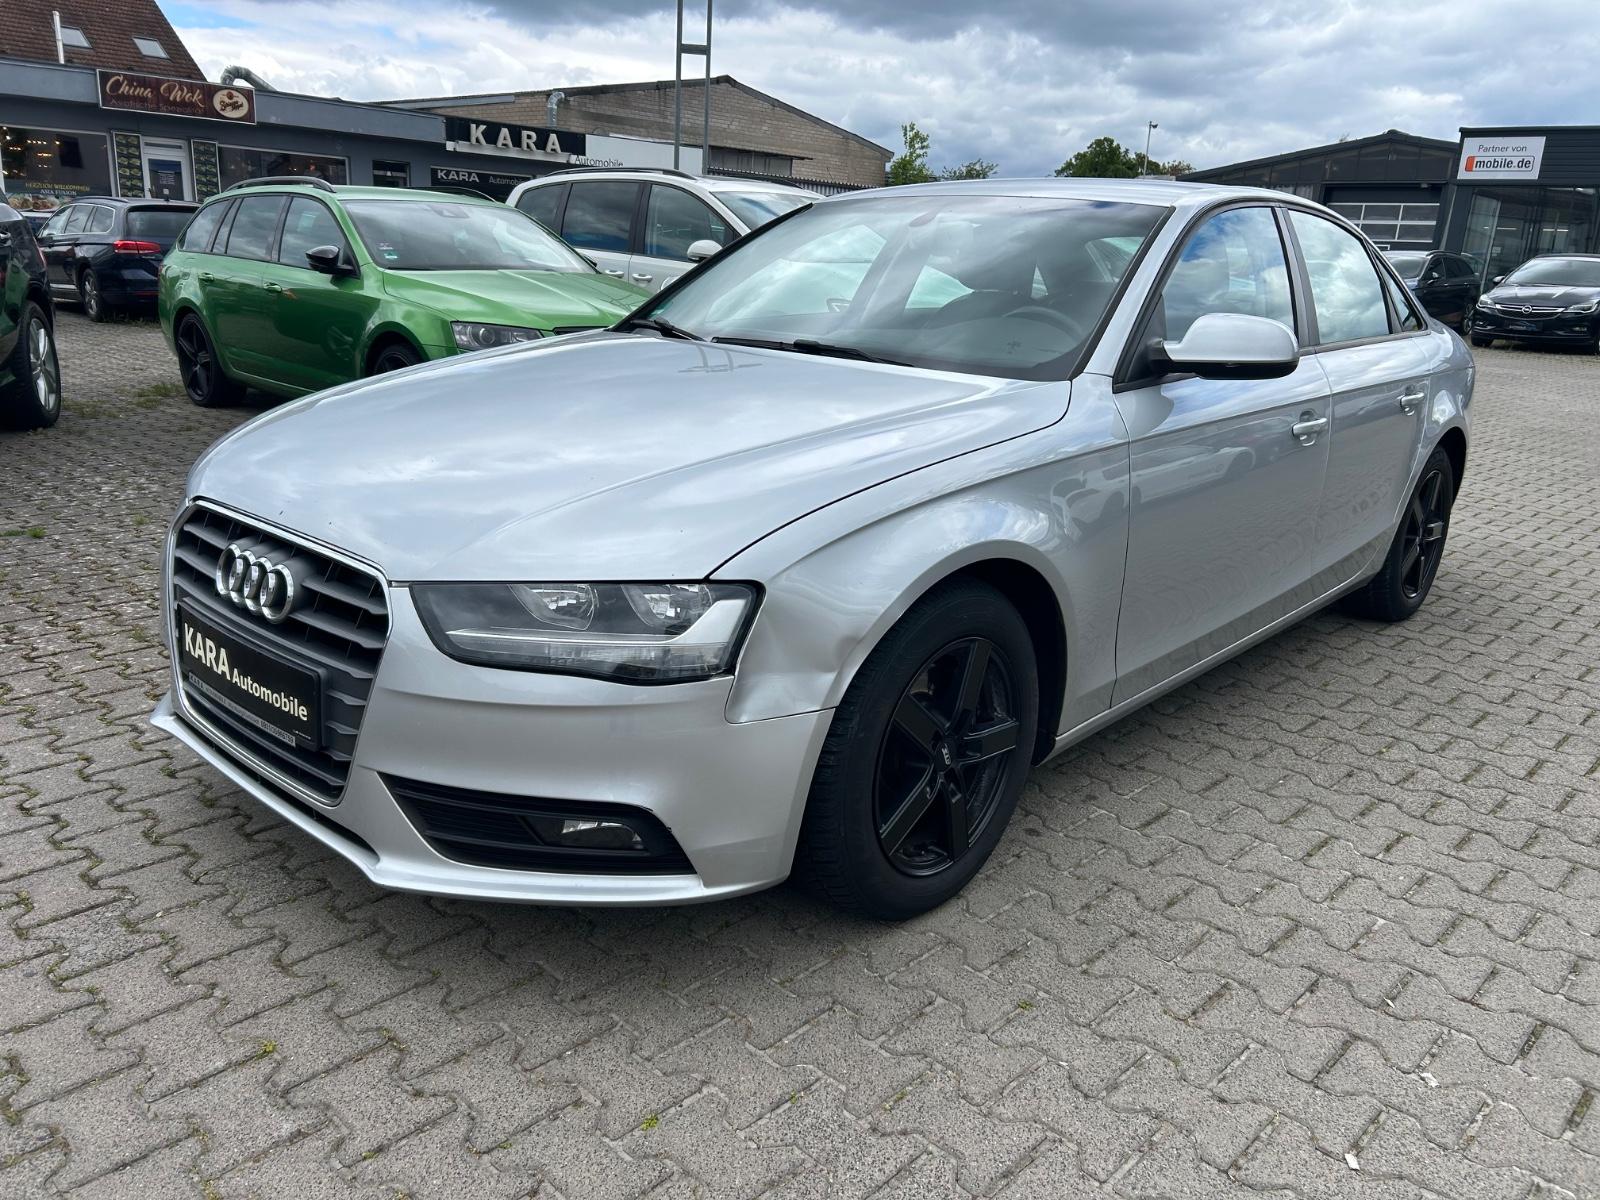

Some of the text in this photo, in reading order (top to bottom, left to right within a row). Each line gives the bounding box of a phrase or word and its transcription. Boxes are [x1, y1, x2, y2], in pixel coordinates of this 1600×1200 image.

[106, 74, 153, 98] China
[160, 81, 205, 108] Wok
[469, 123, 562, 153] KARA
[1478, 144, 1509, 152] Partner
[1474, 158, 1531, 169] mobile.de
[437, 169, 480, 183] KARA
[54, 183, 90, 192] WILLKOMMEN
[184, 622, 231, 681] KARA
[232, 668, 308, 721] Automobile
